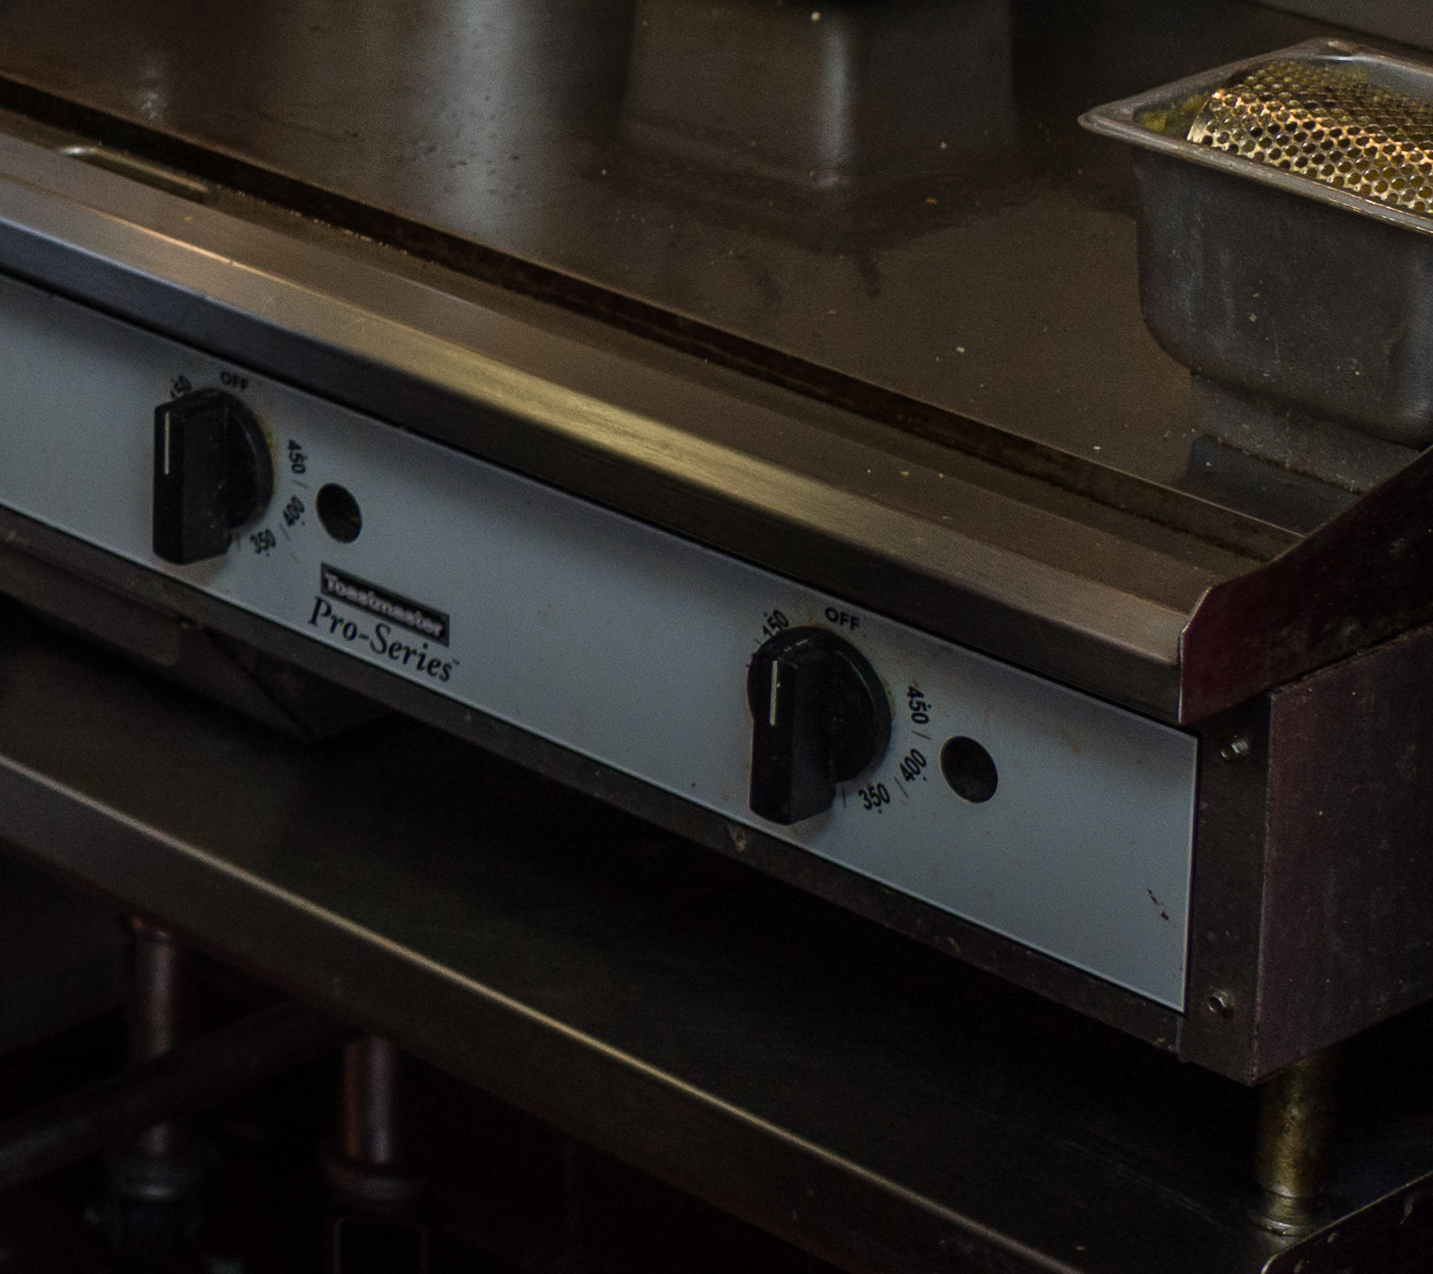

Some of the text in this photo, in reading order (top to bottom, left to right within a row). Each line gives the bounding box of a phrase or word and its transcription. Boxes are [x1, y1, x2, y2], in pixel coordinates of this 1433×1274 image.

[220, 370, 251, 392] OFF
[287, 439, 307, 474] 450
[282, 496, 305, 527] 400
[249, 529, 277, 554] 350
[323, 571, 447, 640] Toastmaster
[824, 607, 861, 631] OFF
[308, 596, 454, 682] Pro-Series
[906, 684, 930, 724] 450
[899, 748, 927, 781] 400
[858, 782, 891, 810] 350
